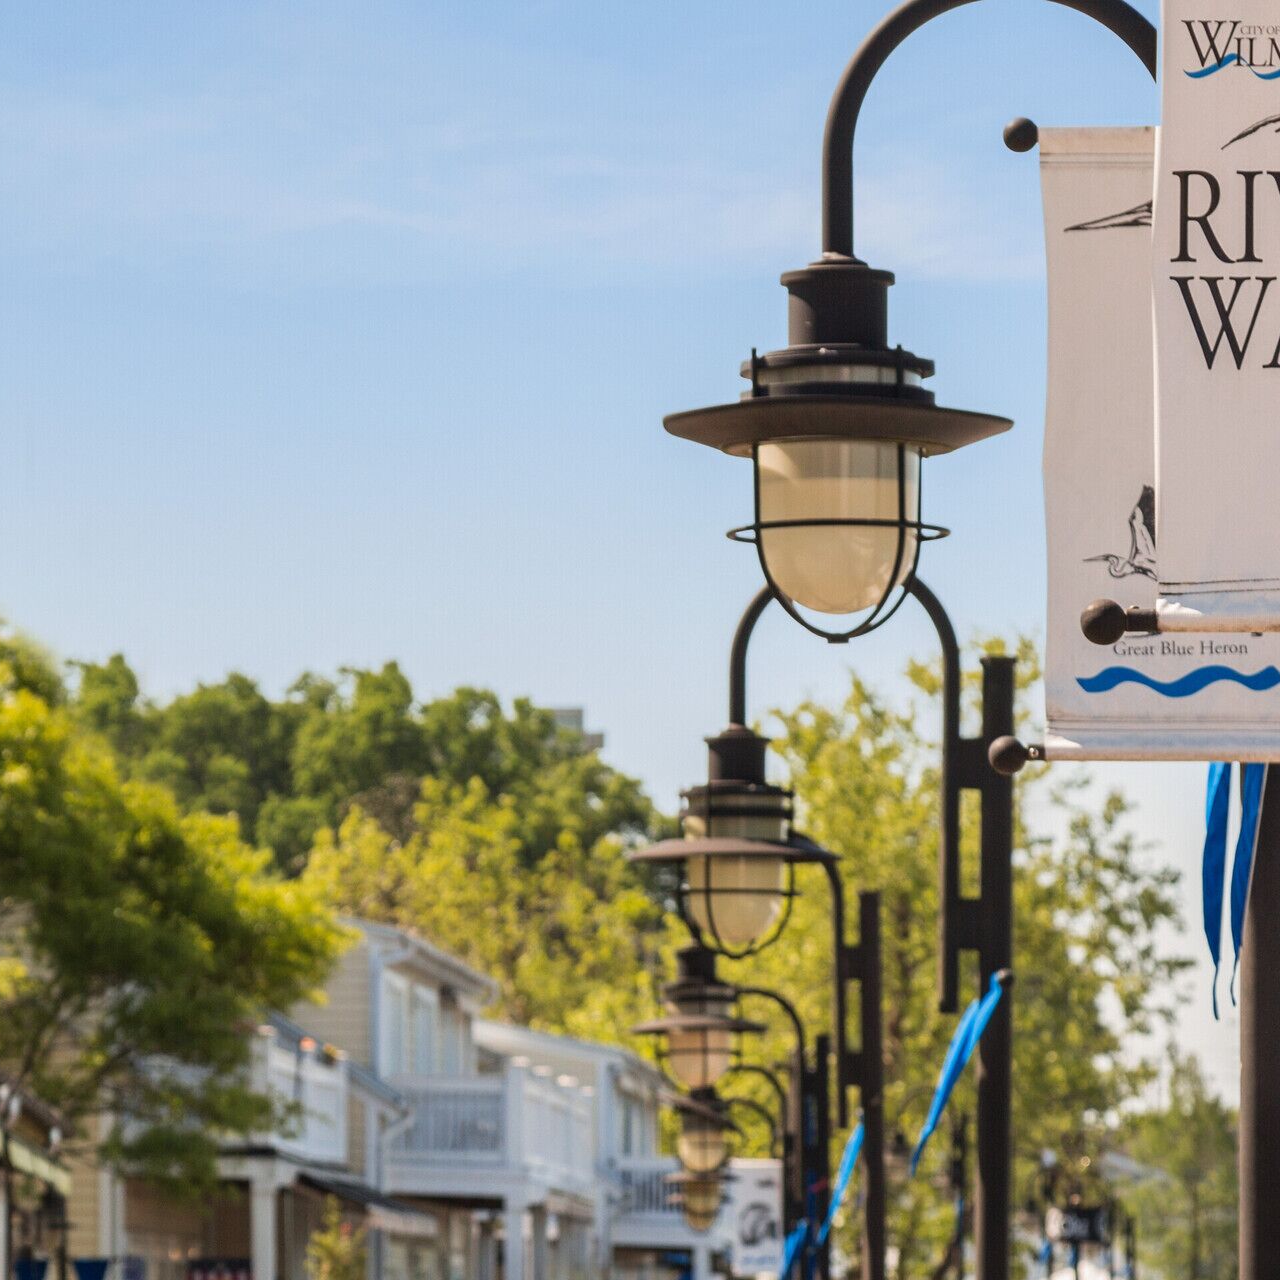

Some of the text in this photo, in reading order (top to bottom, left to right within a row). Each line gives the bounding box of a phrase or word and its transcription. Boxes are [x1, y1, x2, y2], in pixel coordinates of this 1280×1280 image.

[1240, 25, 1280, 35] CITY OF
[1113, 640, 1249, 657] Great Blue Heron
